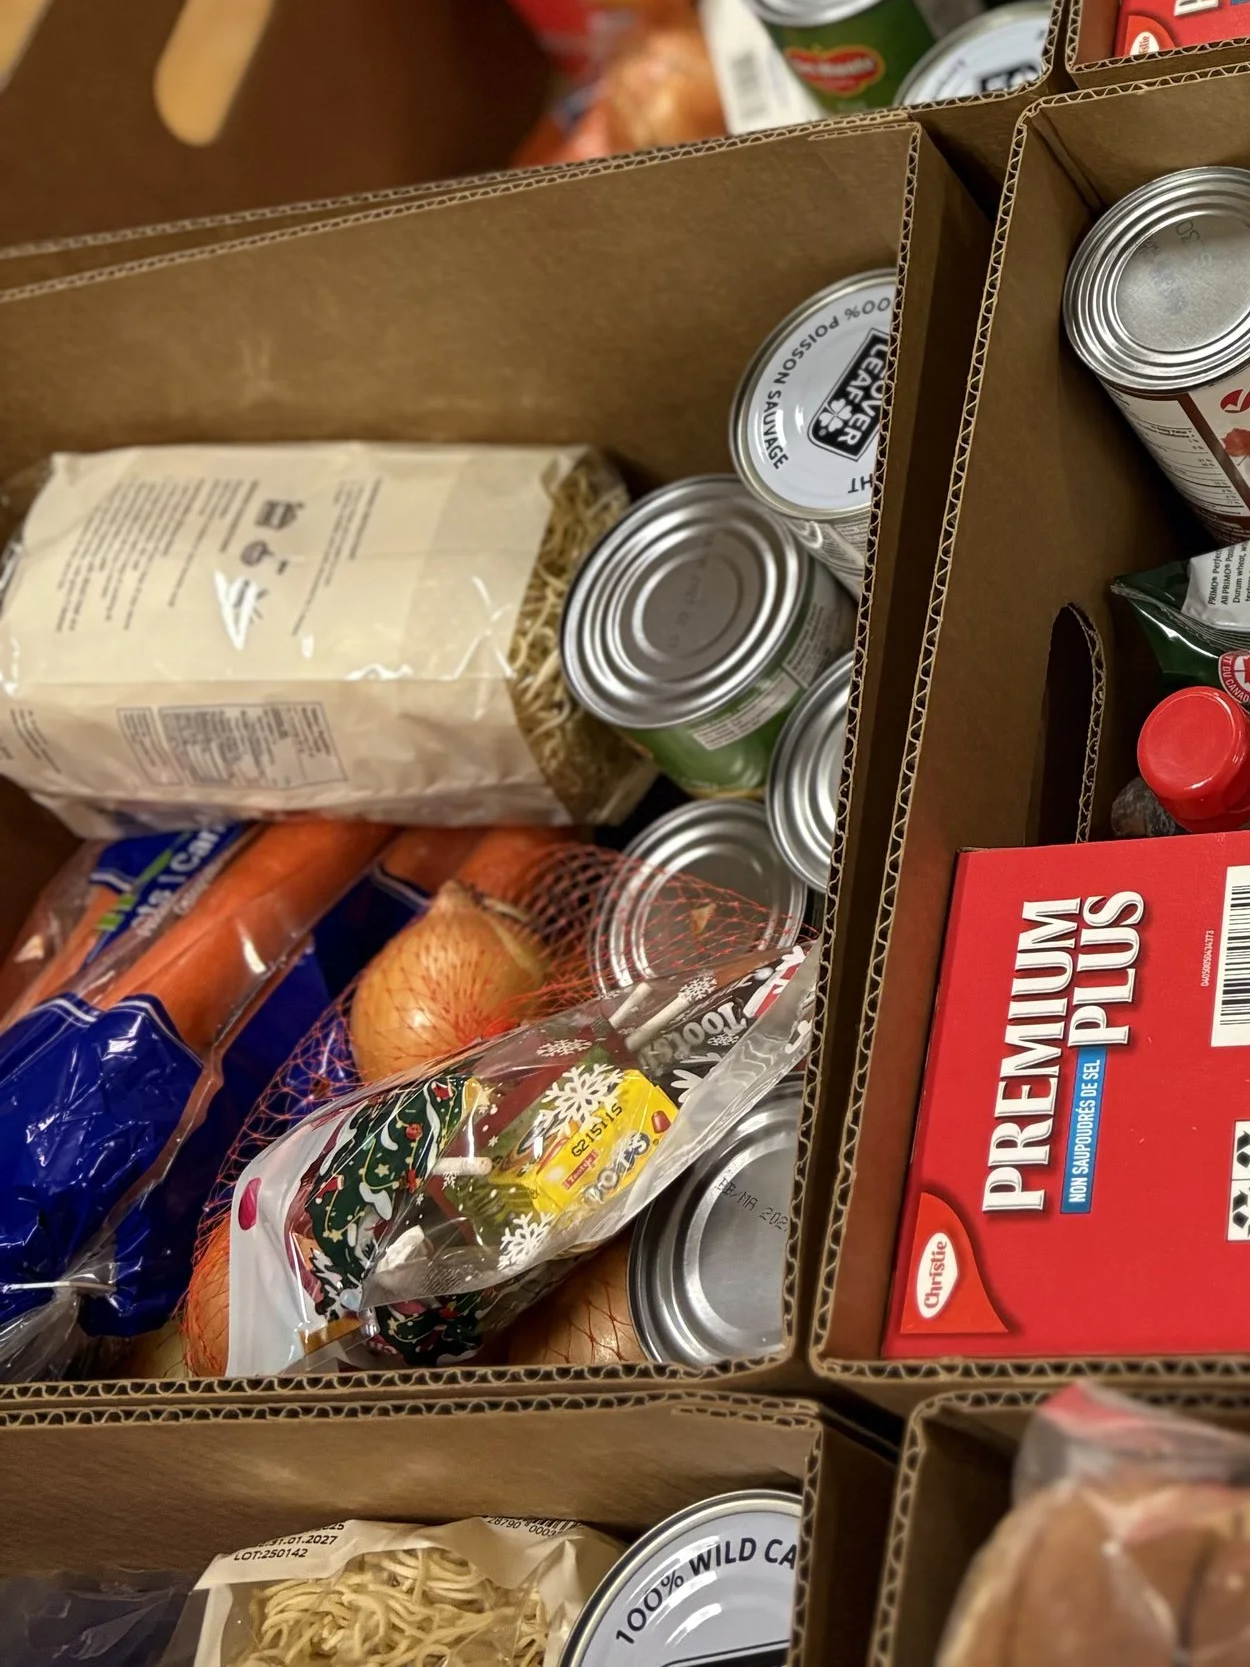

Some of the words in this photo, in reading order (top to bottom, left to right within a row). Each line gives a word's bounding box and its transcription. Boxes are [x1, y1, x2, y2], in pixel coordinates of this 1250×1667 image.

[772, 315, 841, 387] POISSON
[762, 389, 791, 471] SAUVAGE
[1232, 577, 1242, 604] Durum
[1222, 666, 1232, 678] DU
[1066, 889, 1145, 1048] PLUS
[981, 897, 1084, 1214] PREMIUM
[1082, 1059, 1101, 1081] SEL
[1080, 1081, 1098, 1097] DE
[1072, 1098, 1097, 1178] SAUPOUDRÉS
[1068, 1178, 1087, 1204] NON
[759, 1206, 789, 1232] 202
[923, 1239, 948, 1310] Christie
[233, 1547, 309, 1562] LOT:250142
[615, 1569, 685, 1645] 100%
[688, 1537, 757, 1577] WILD
